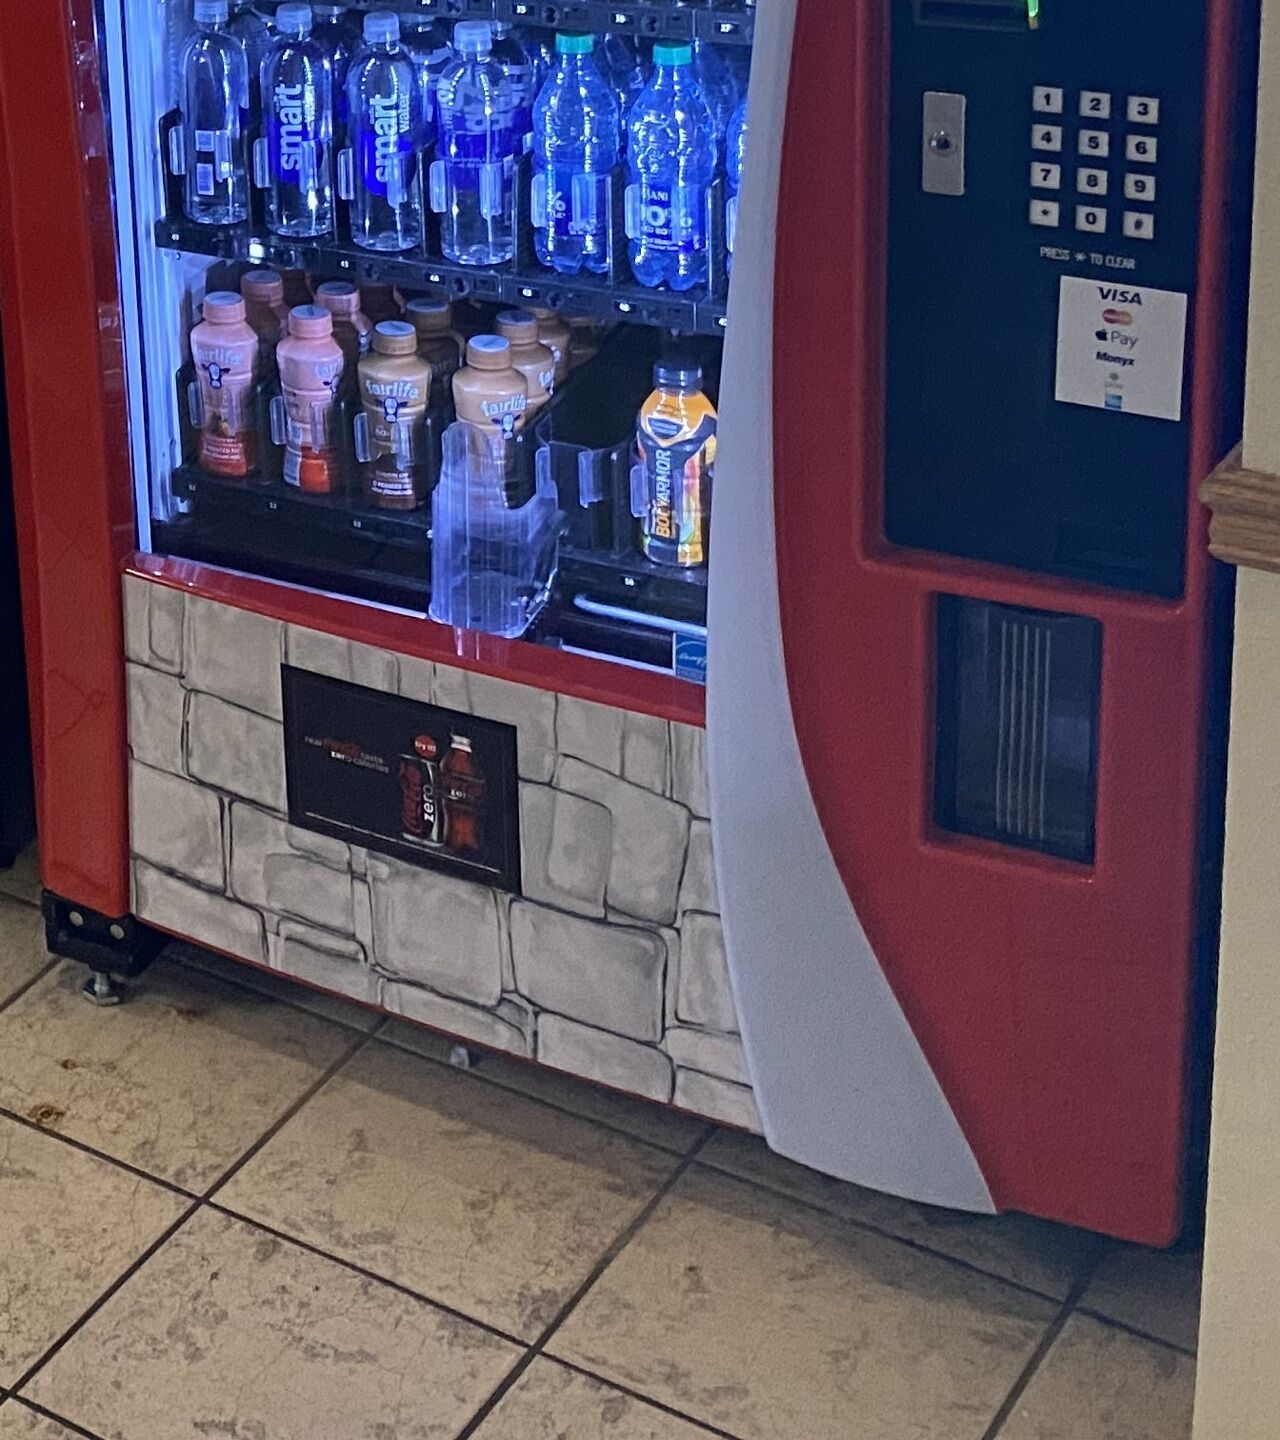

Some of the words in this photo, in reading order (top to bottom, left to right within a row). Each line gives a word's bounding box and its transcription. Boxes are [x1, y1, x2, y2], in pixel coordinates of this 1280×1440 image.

[1043, 92, 1051, 106] 1
[1090, 98, 1101, 111] 2
[1137, 103, 1149, 116] 3
[274, 83, 302, 172] smart
[369, 94, 397, 183] smart
[1041, 131, 1052, 144] 4
[1088, 136, 1099, 149] 5
[1135, 141, 1148, 155] 6
[1040, 168, 1051, 181] 7
[1086, 174, 1098, 187] 8
[1134, 179, 1146, 193] 9
[1085, 212, 1097, 225] 0
[1040, 246, 1070, 261] PRESS
[1090, 253, 1103, 266] TO
[1105, 255, 1136, 270] CLEAR
[1097, 286, 1143, 306] VISA
[1110, 330, 1139, 350] Pay
[365, 378, 419, 399] fairlife
[422, 784, 435, 823] zero
